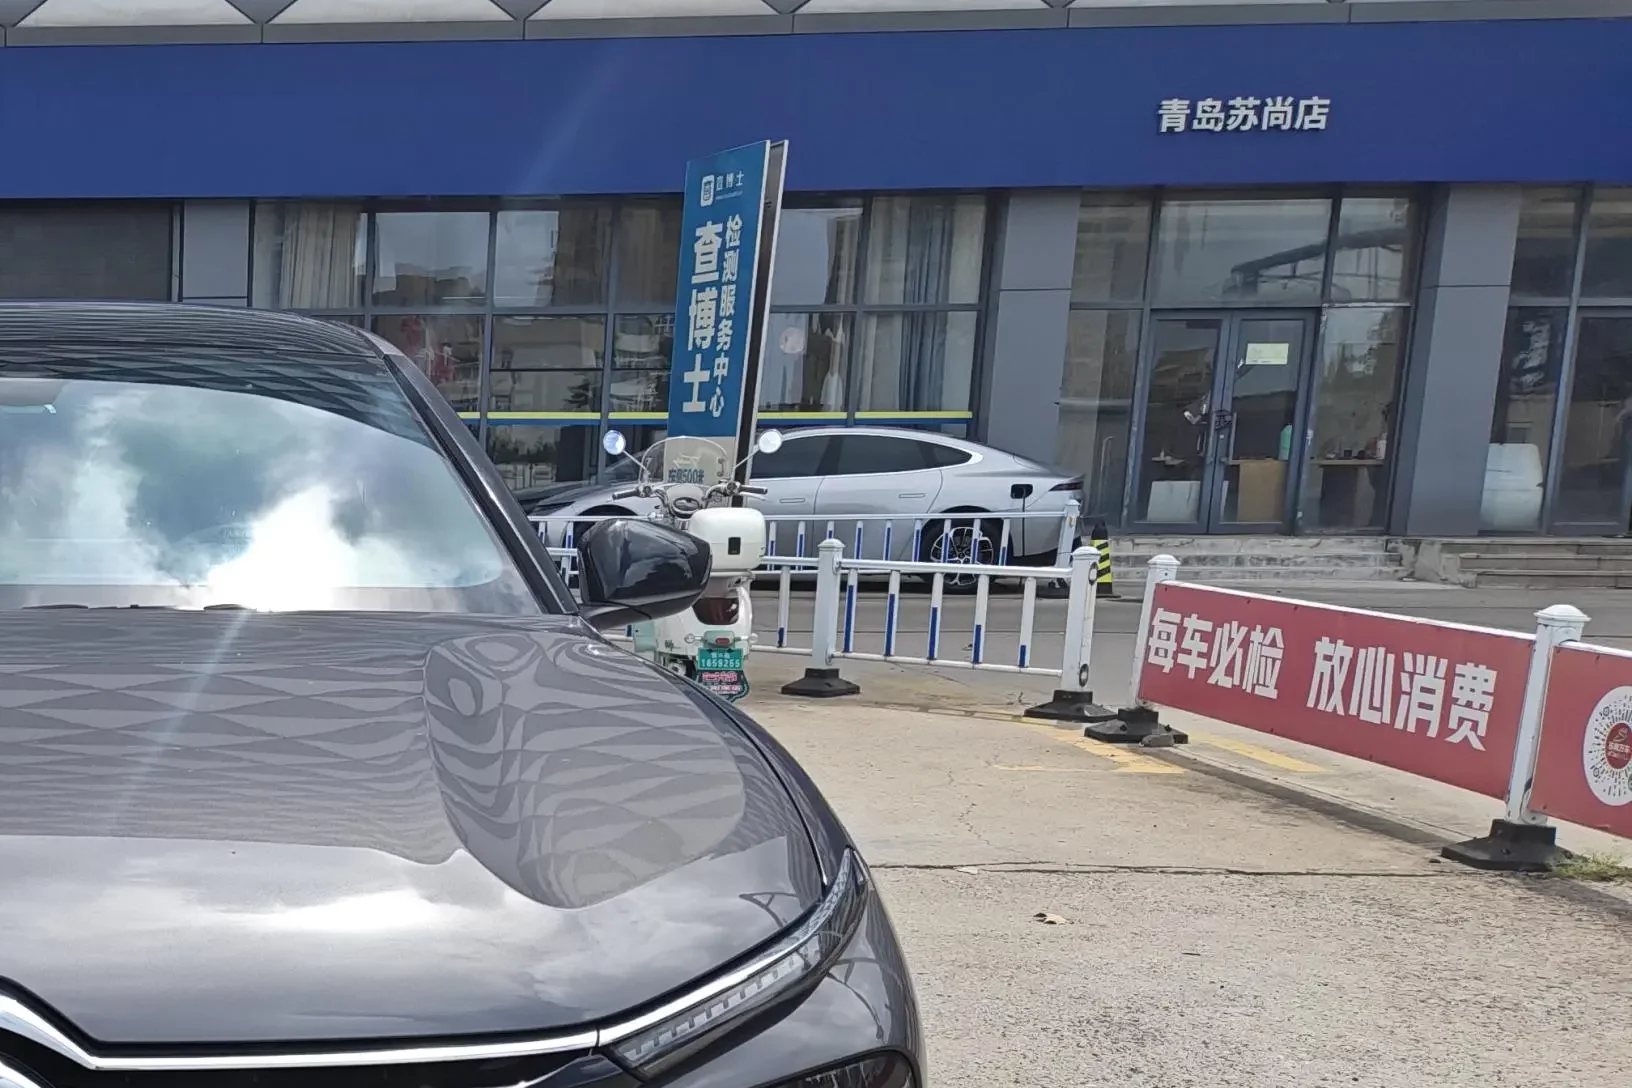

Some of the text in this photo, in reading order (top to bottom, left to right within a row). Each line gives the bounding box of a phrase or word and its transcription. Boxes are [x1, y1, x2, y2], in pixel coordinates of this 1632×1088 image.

[1158, 96, 1331, 132] 青岛苏尚店
[682, 220, 723, 413] 查博士
[708, 214, 743, 418] 检测服务中心
[1147, 607, 1498, 751] 每车必检 放心消费
